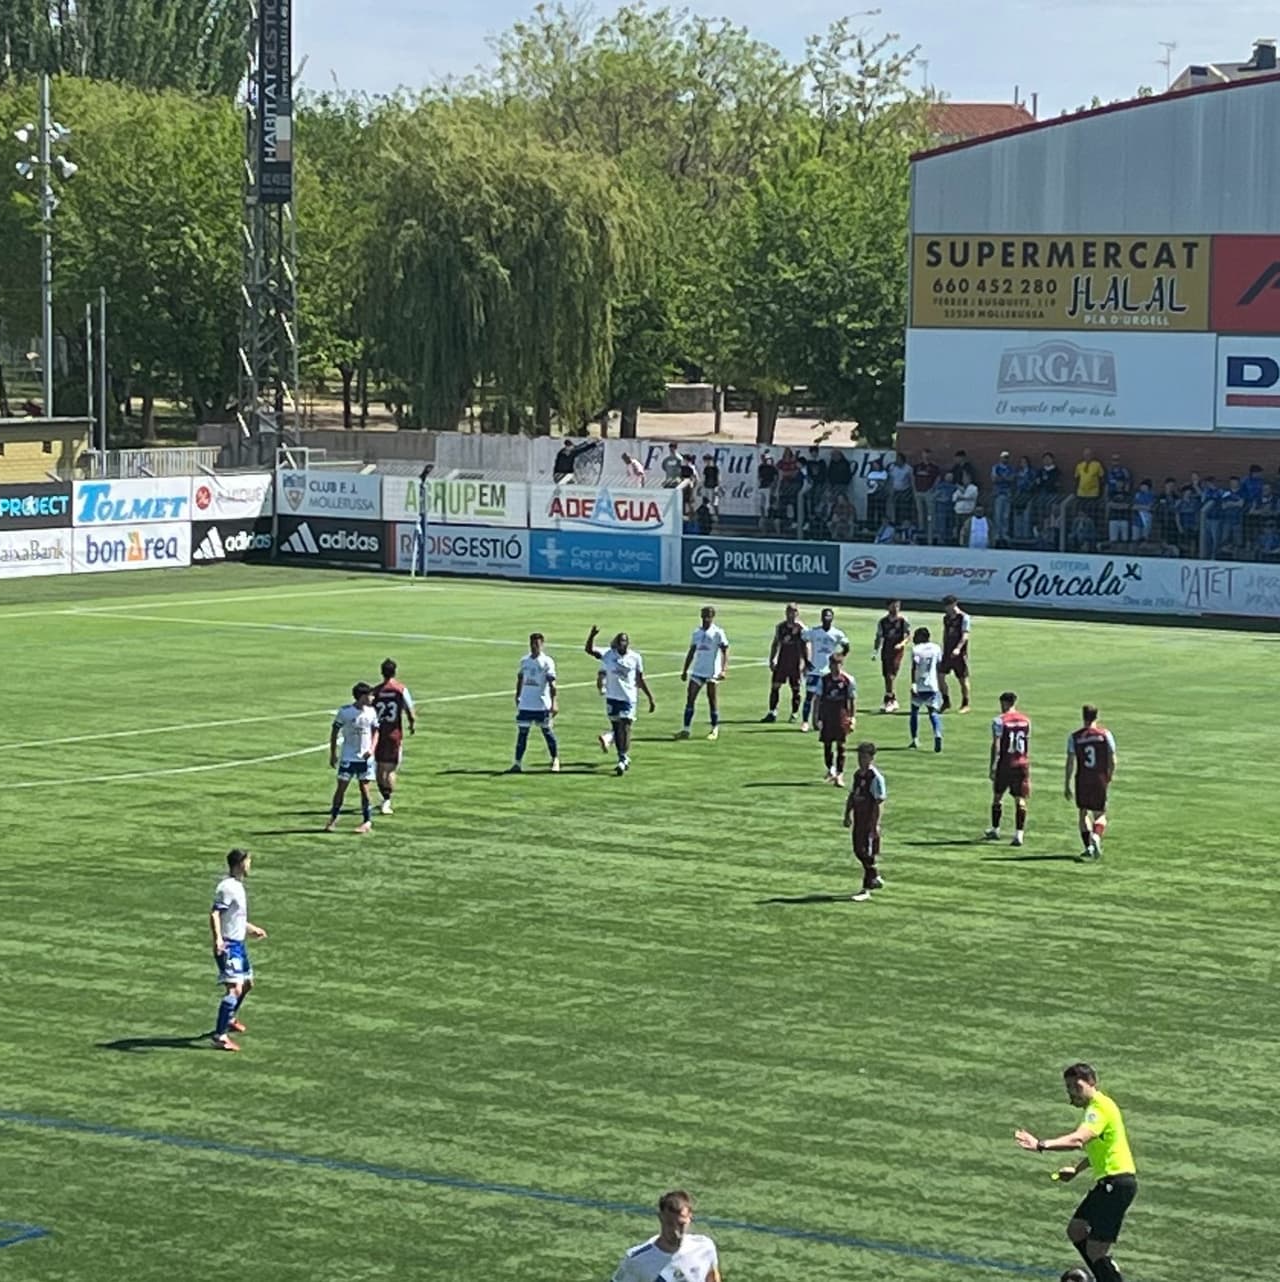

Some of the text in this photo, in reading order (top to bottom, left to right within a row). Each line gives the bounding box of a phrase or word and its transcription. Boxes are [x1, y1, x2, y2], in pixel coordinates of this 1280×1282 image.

[926, 240, 1199, 269] SUPERMERCAT
[932, 278, 1058, 294] 660 452 280
[1067, 274, 1188, 316] HALAL
[1084, 314, 1107, 325] PLA
[1003, 351, 1110, 386] ARGAL
[309, 481, 337, 493] CLUB
[78, 484, 187, 523] TOLMET
[309, 497, 375, 512] MOLLERUSSA
[225, 530, 271, 552] adidas
[320, 529, 379, 552] adidas
[724, 551, 830, 574] PREVINTEGRAL
[1050, 560, 1091, 572] LOTERIA
[376, 701, 398, 723] 23
[1007, 730, 1026, 755] 16
[1084, 745, 1096, 769] 3
